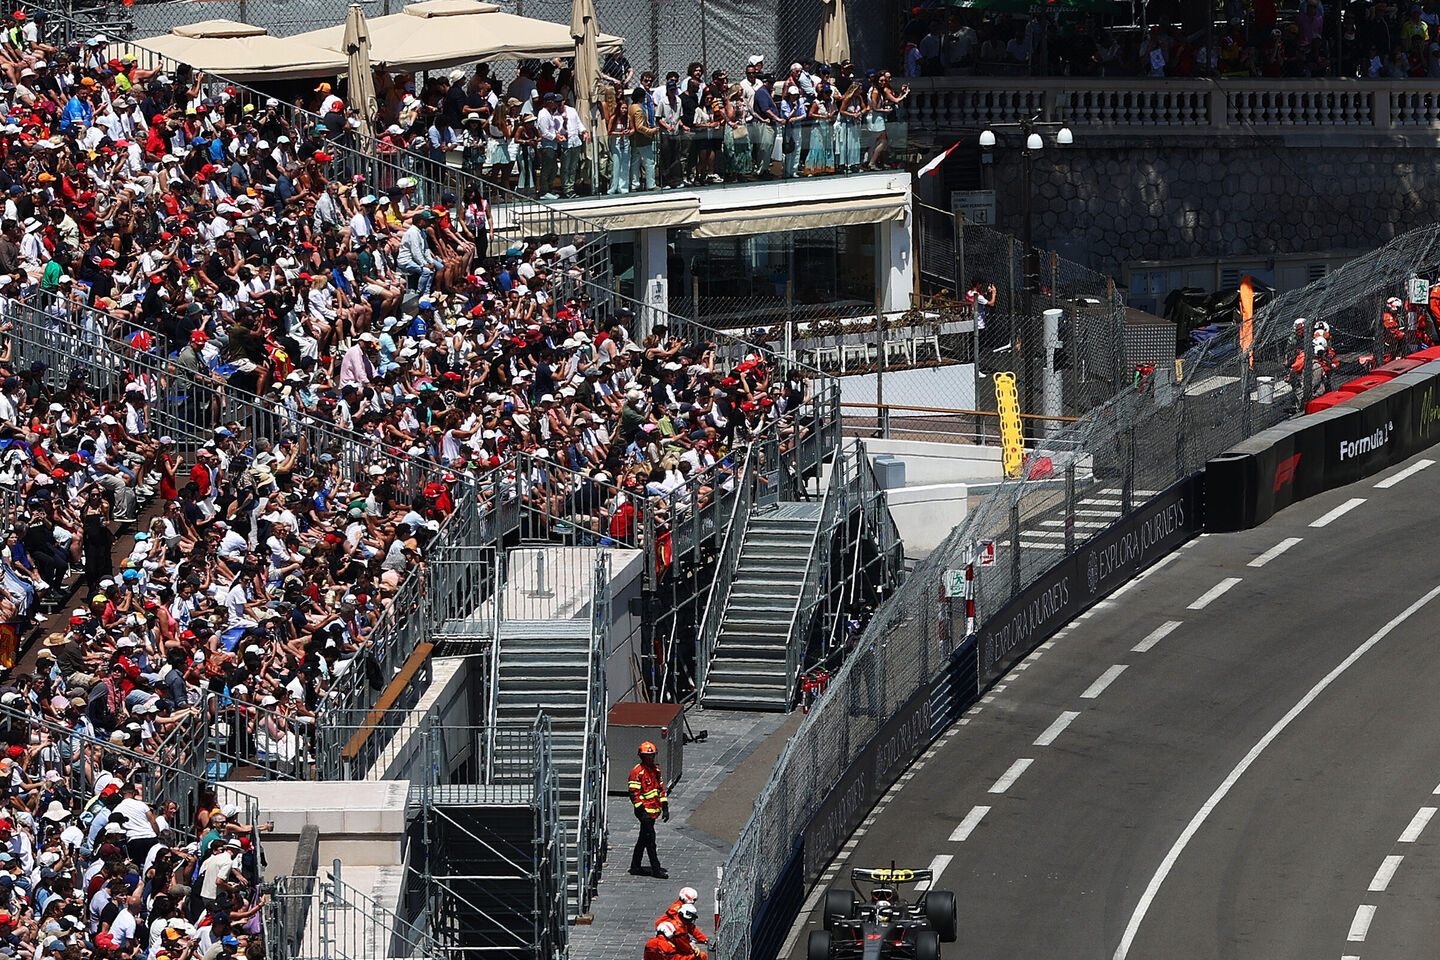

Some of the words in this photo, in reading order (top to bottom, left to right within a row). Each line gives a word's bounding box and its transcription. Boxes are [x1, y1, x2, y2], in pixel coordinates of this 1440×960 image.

[1340, 428, 1384, 461] Formula
[1100, 532, 1139, 580] EXPLORA
[1138, 497, 1185, 561] JOURNEYS
